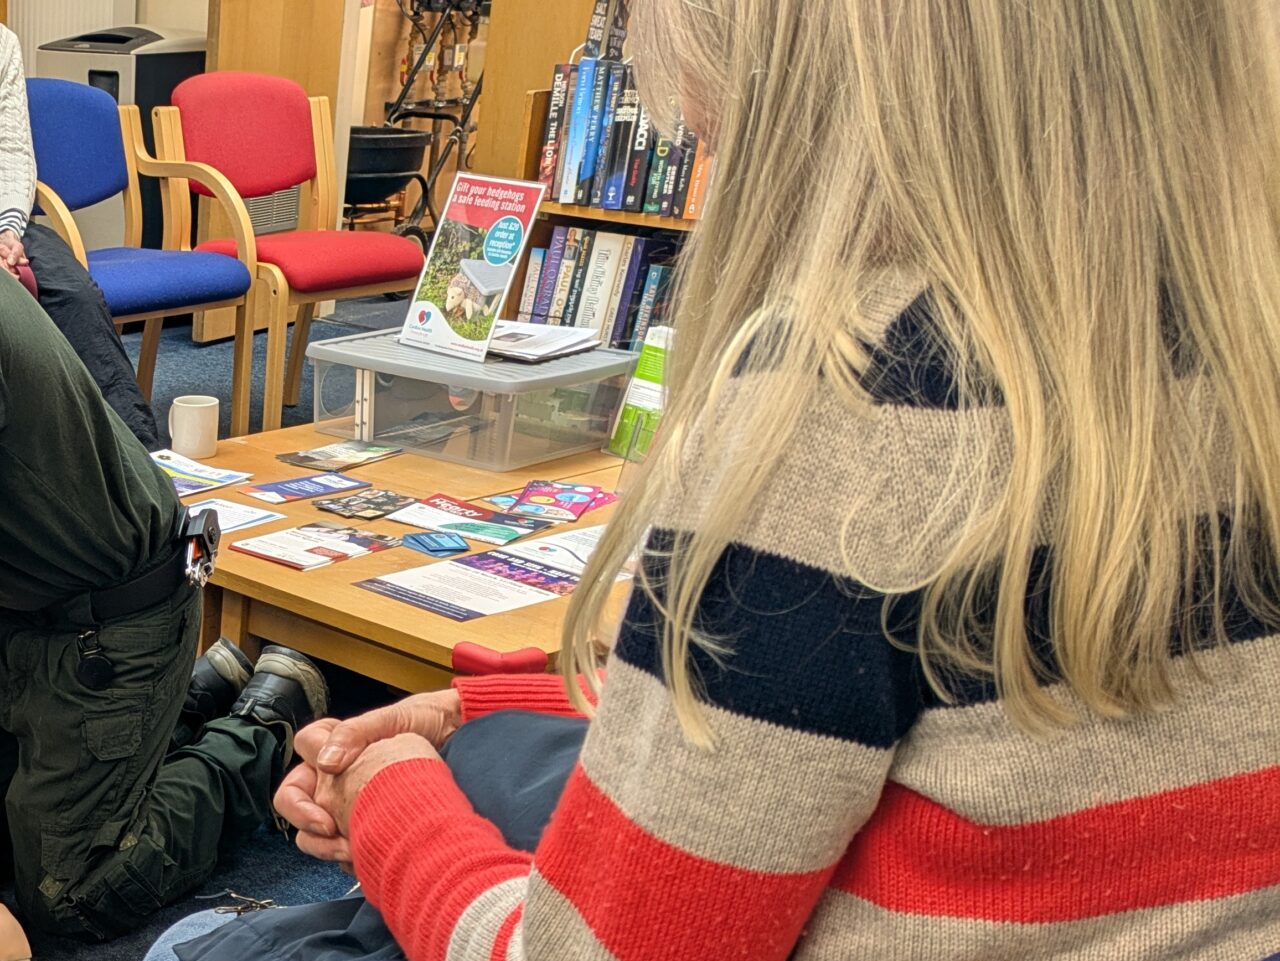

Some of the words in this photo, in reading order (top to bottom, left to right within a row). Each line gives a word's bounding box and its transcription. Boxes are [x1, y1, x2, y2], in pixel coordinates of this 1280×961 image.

[548, 73, 564, 119] DEMILLE
[593, 66, 606, 113] MATTHEW
[547, 121, 558, 140] THE
[588, 115, 599, 142] PERRY
[544, 139, 555, 165] LION
[452, 194, 457, 202] a
[458, 194, 474, 205] safe
[474, 196, 500, 211] feeding
[500, 201, 526, 213] station
[456, 182, 470, 192] Gift
[470, 185, 486, 196] your
[487, 186, 525, 203] hedgehogs
[495, 231, 508, 239] order
[551, 236, 565, 264] PAUL
[559, 265, 572, 292] PAUL
[539, 270, 557, 321] O'GRADY
